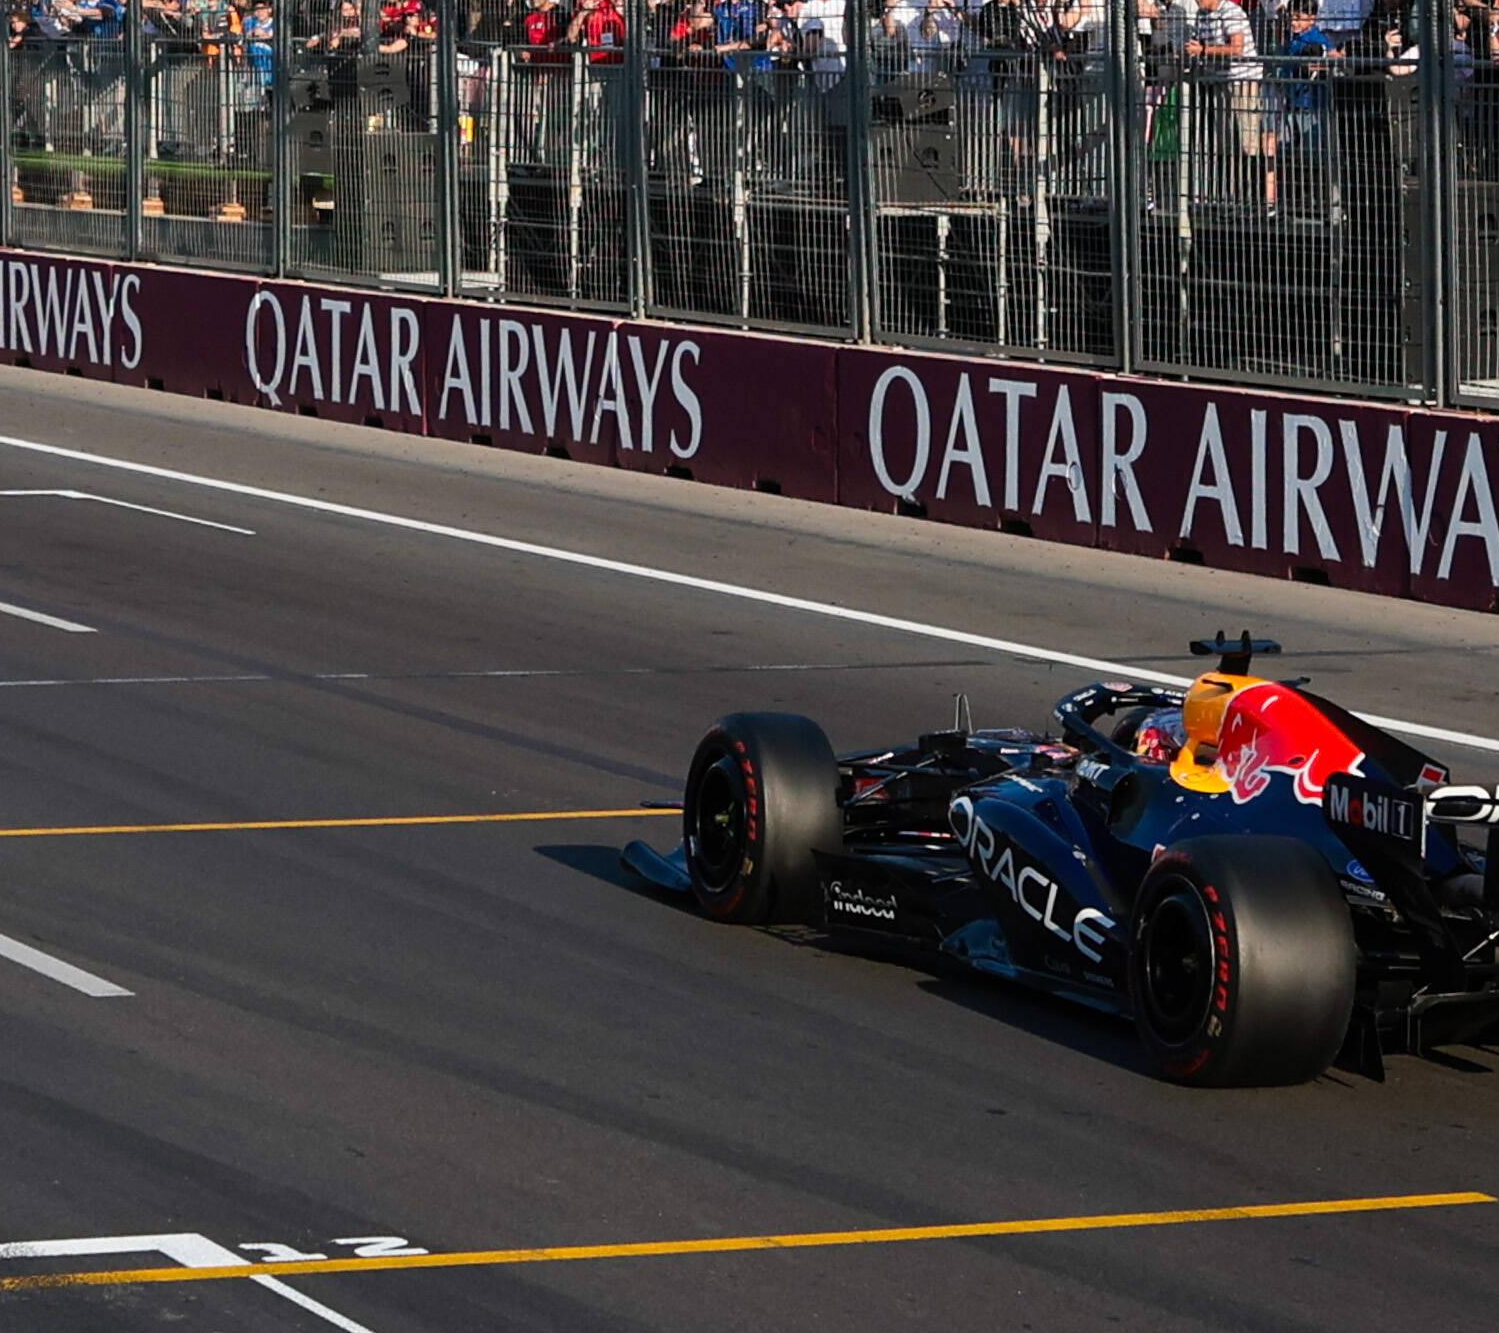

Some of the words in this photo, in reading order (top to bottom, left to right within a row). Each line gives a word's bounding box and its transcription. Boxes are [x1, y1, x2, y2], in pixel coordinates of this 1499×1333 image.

[245, 290, 422, 417] QATAR
[438, 313, 703, 459] AIRWAYS
[868, 365, 1154, 533] QATAR
[948, 796, 1117, 964] ORACLE
[1330, 784, 1389, 834] Mobil
[1397, 804, 1406, 835] 1
